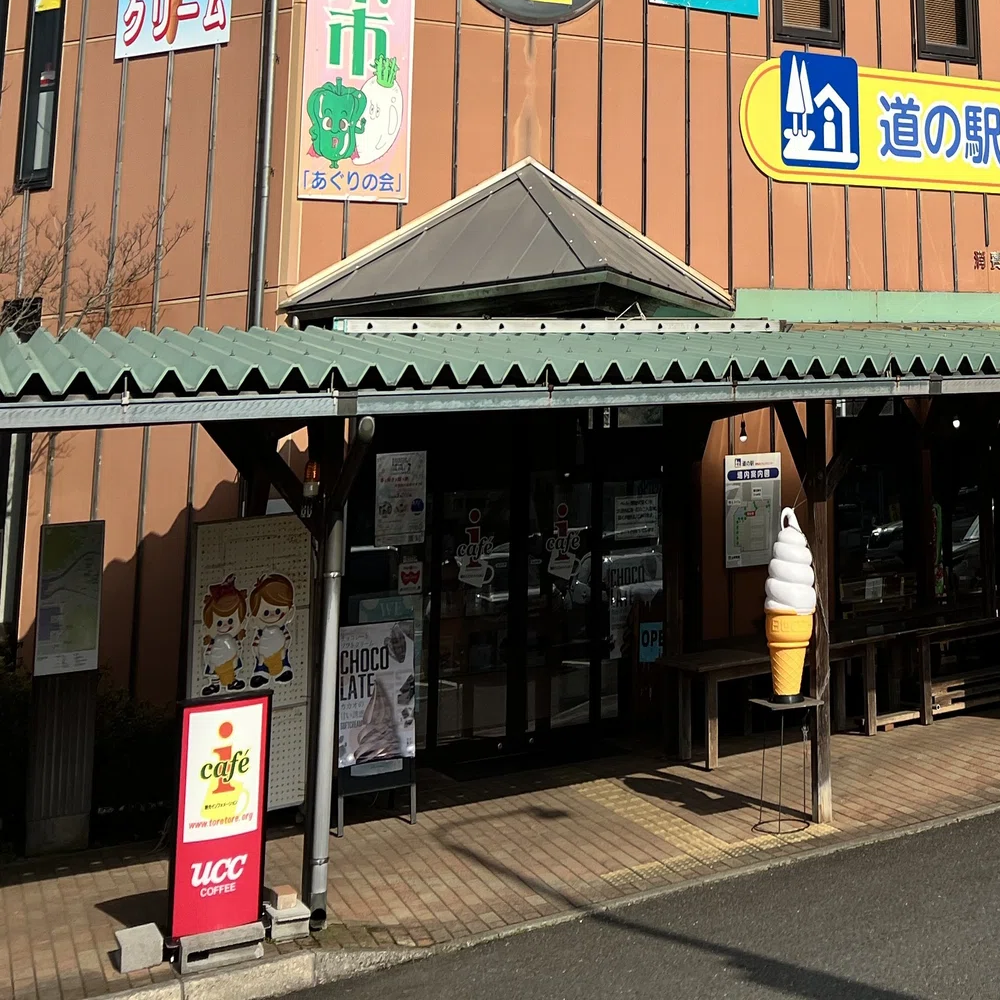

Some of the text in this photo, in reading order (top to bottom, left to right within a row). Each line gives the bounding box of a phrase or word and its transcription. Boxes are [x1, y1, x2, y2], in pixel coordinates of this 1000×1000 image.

[456, 534, 495, 561] café
[545, 529, 581, 555] café
[642, 630, 664, 647] OPE
[340, 646, 389, 674] CHOCO
[340, 673, 376, 700] LATE
[200, 749, 251, 782] café
[199, 882, 236, 898] COFFEE
